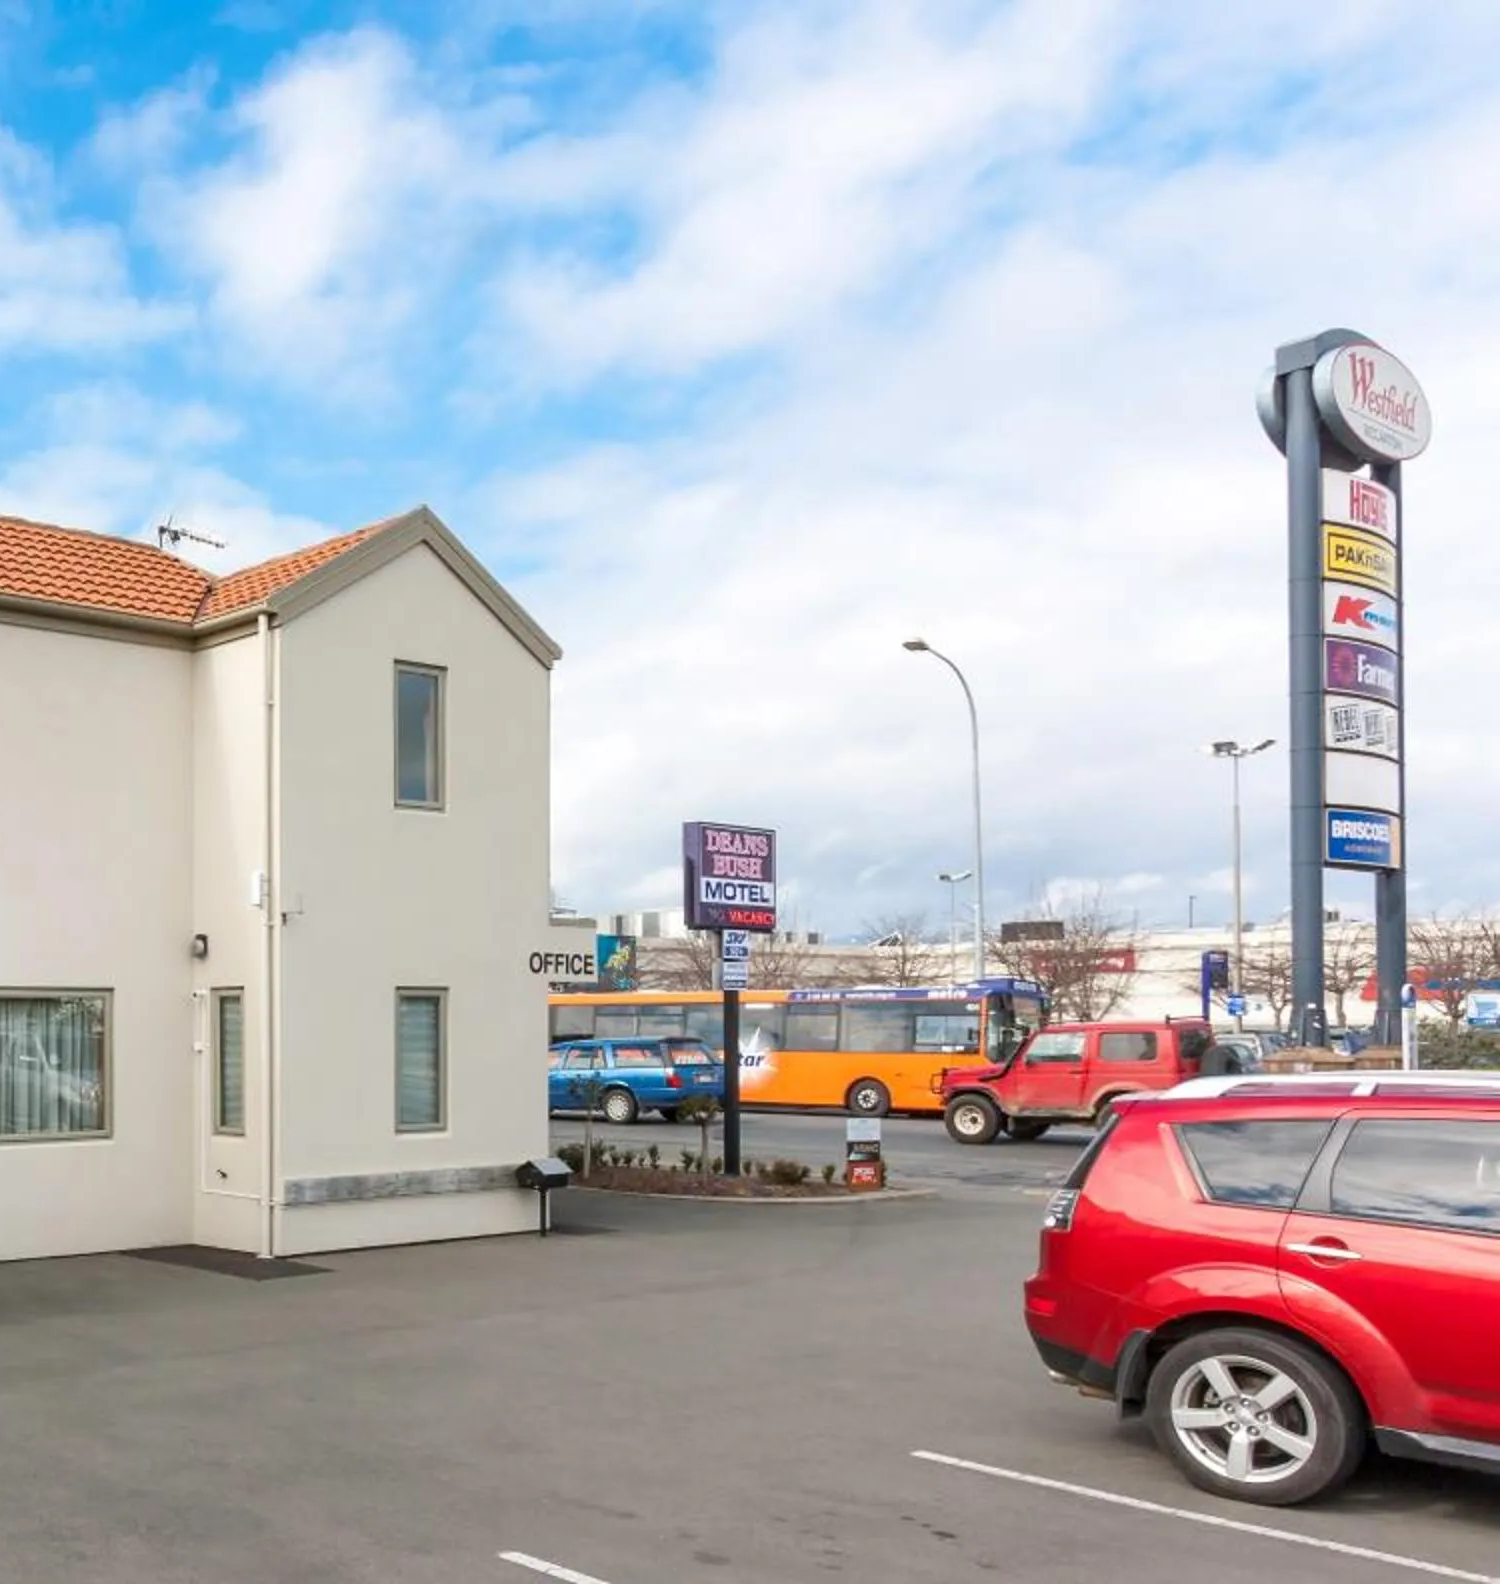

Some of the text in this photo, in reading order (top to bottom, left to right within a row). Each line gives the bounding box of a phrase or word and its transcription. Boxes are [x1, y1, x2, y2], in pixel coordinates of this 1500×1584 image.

[1348, 352, 1417, 432] Westfield
[705, 830, 769, 857] DEANS
[713, 855, 763, 879] BUSH
[705, 881, 770, 903] MOTEL
[529, 951, 595, 975] OFFICE
